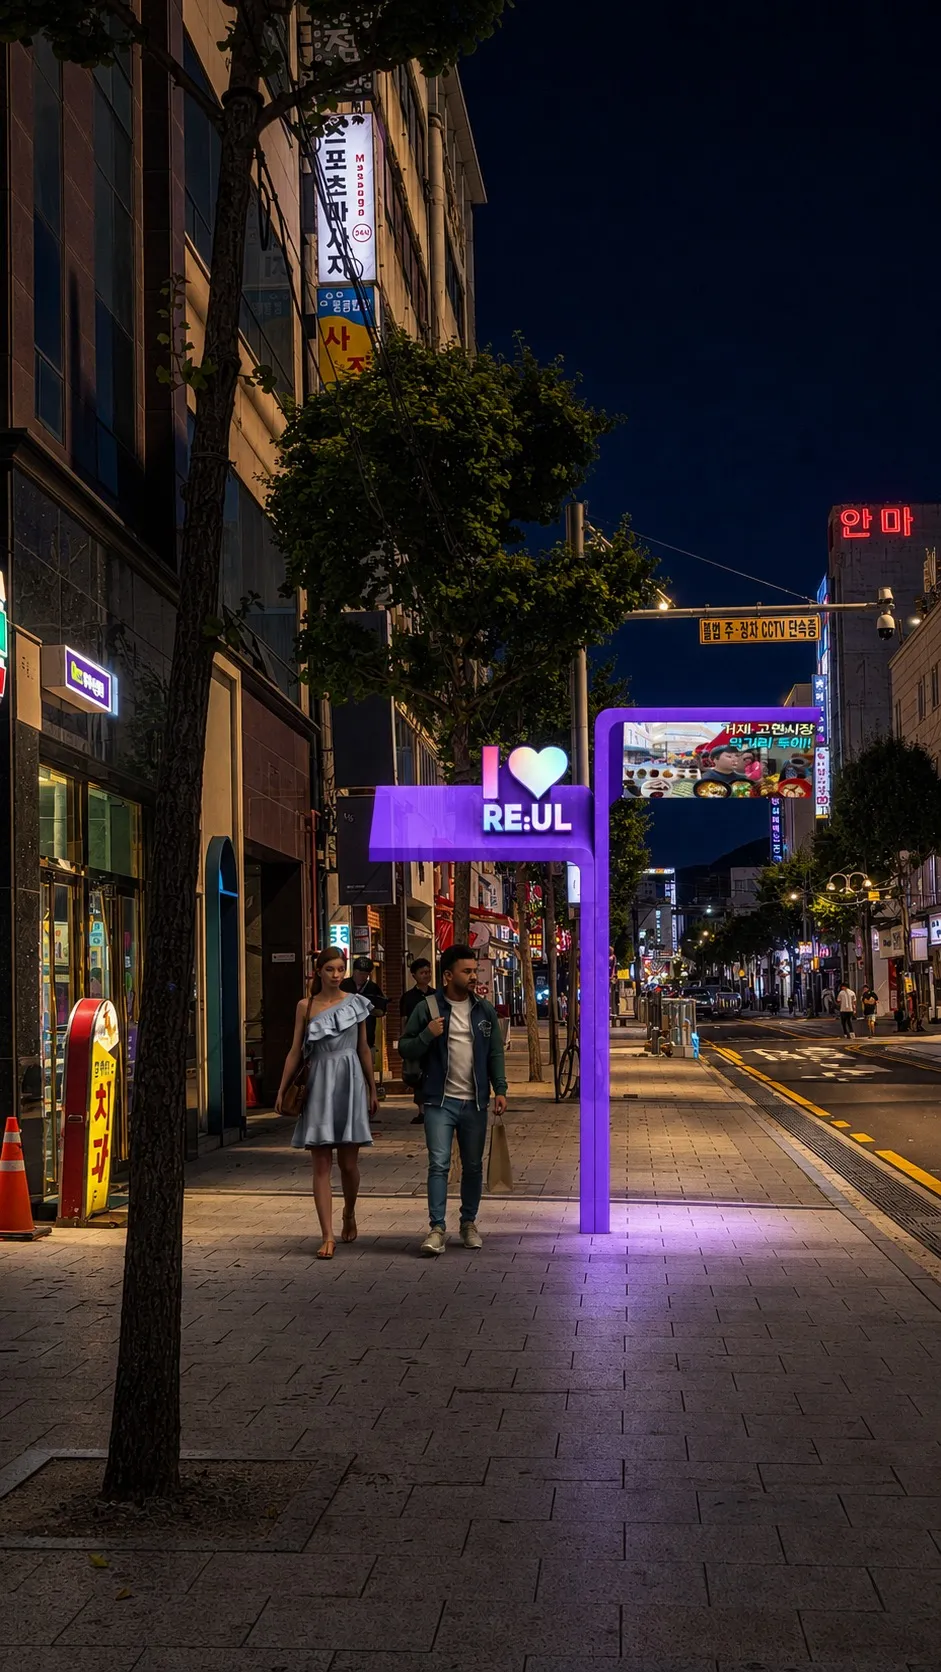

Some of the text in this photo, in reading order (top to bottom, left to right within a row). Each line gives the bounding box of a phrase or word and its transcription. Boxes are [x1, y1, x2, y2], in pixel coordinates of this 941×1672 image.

[839, 506, 914, 539] 안마
[761, 620, 785, 638] CCTV
[482, 745, 499, 799] I
[482, 803, 572, 831] RE:UL
[91, 1080, 111, 1184] 치과
